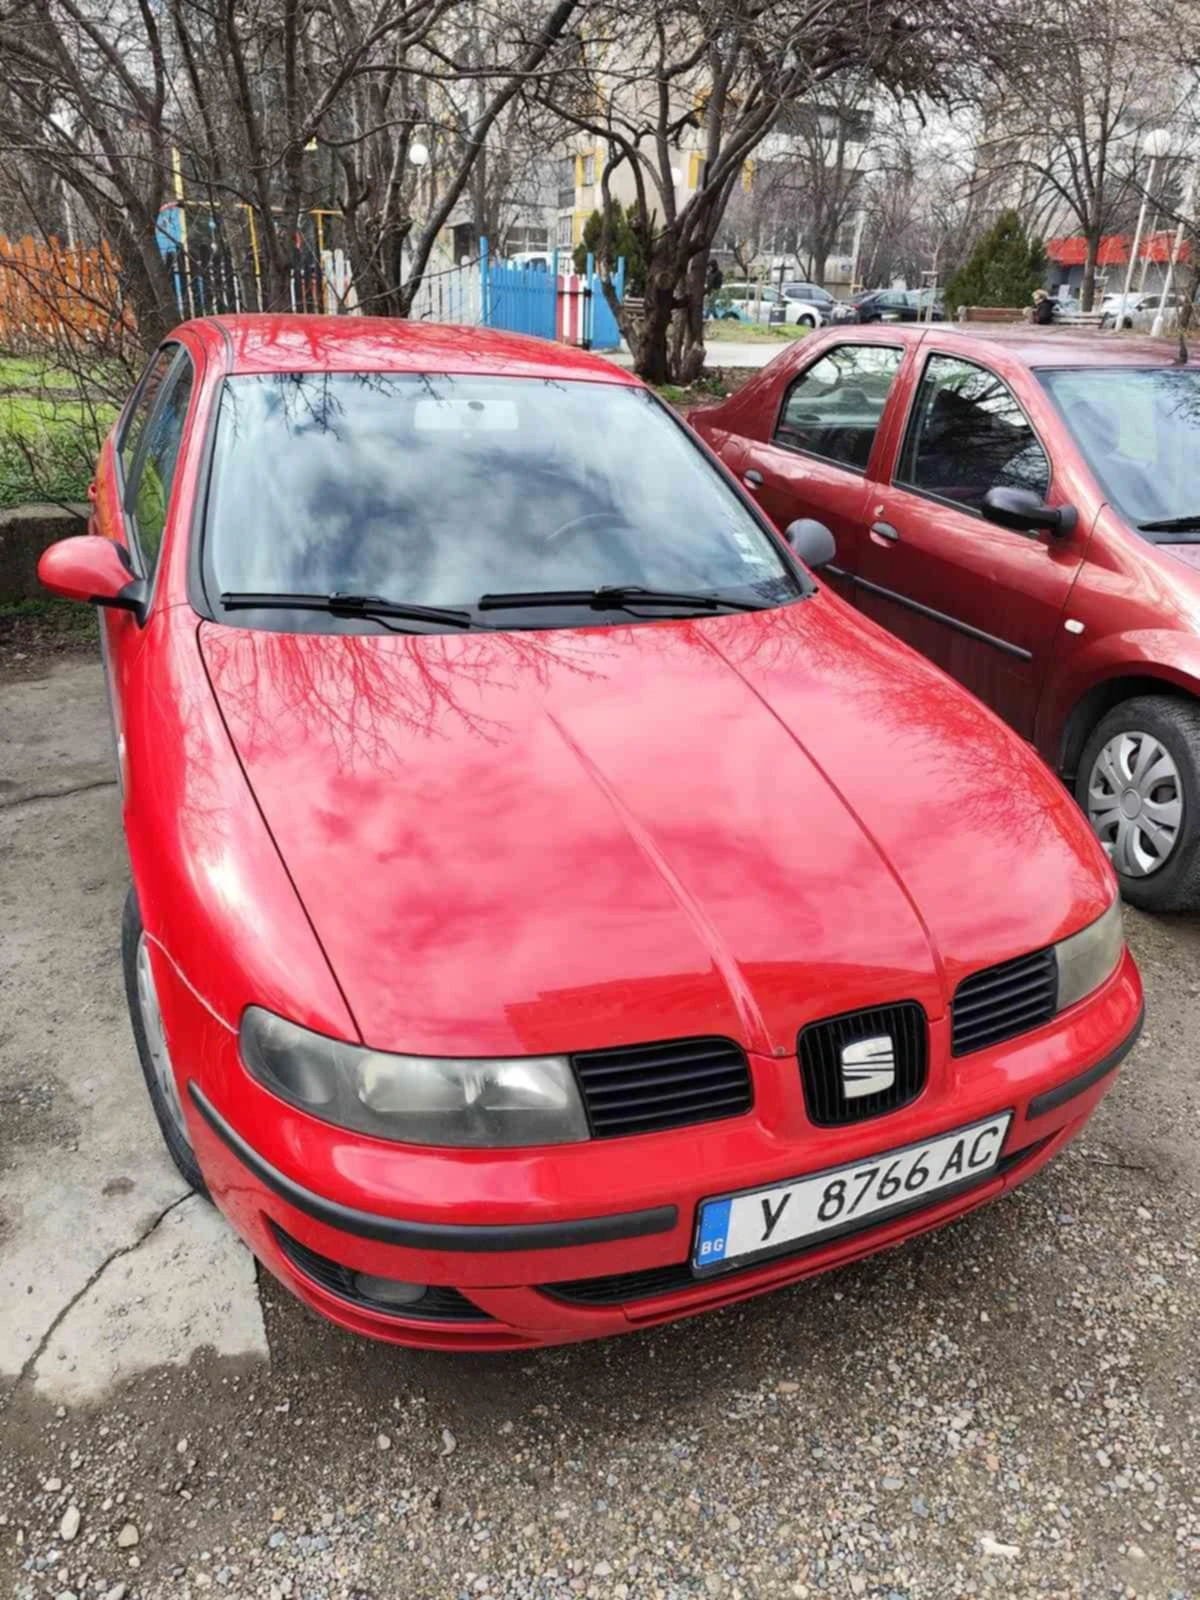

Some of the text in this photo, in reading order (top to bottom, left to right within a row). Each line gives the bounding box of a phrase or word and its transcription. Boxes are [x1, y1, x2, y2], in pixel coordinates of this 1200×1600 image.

[817, 1151, 930, 1222] 8766
[938, 1126, 999, 1182] AC
[701, 1238, 724, 1256] BG
